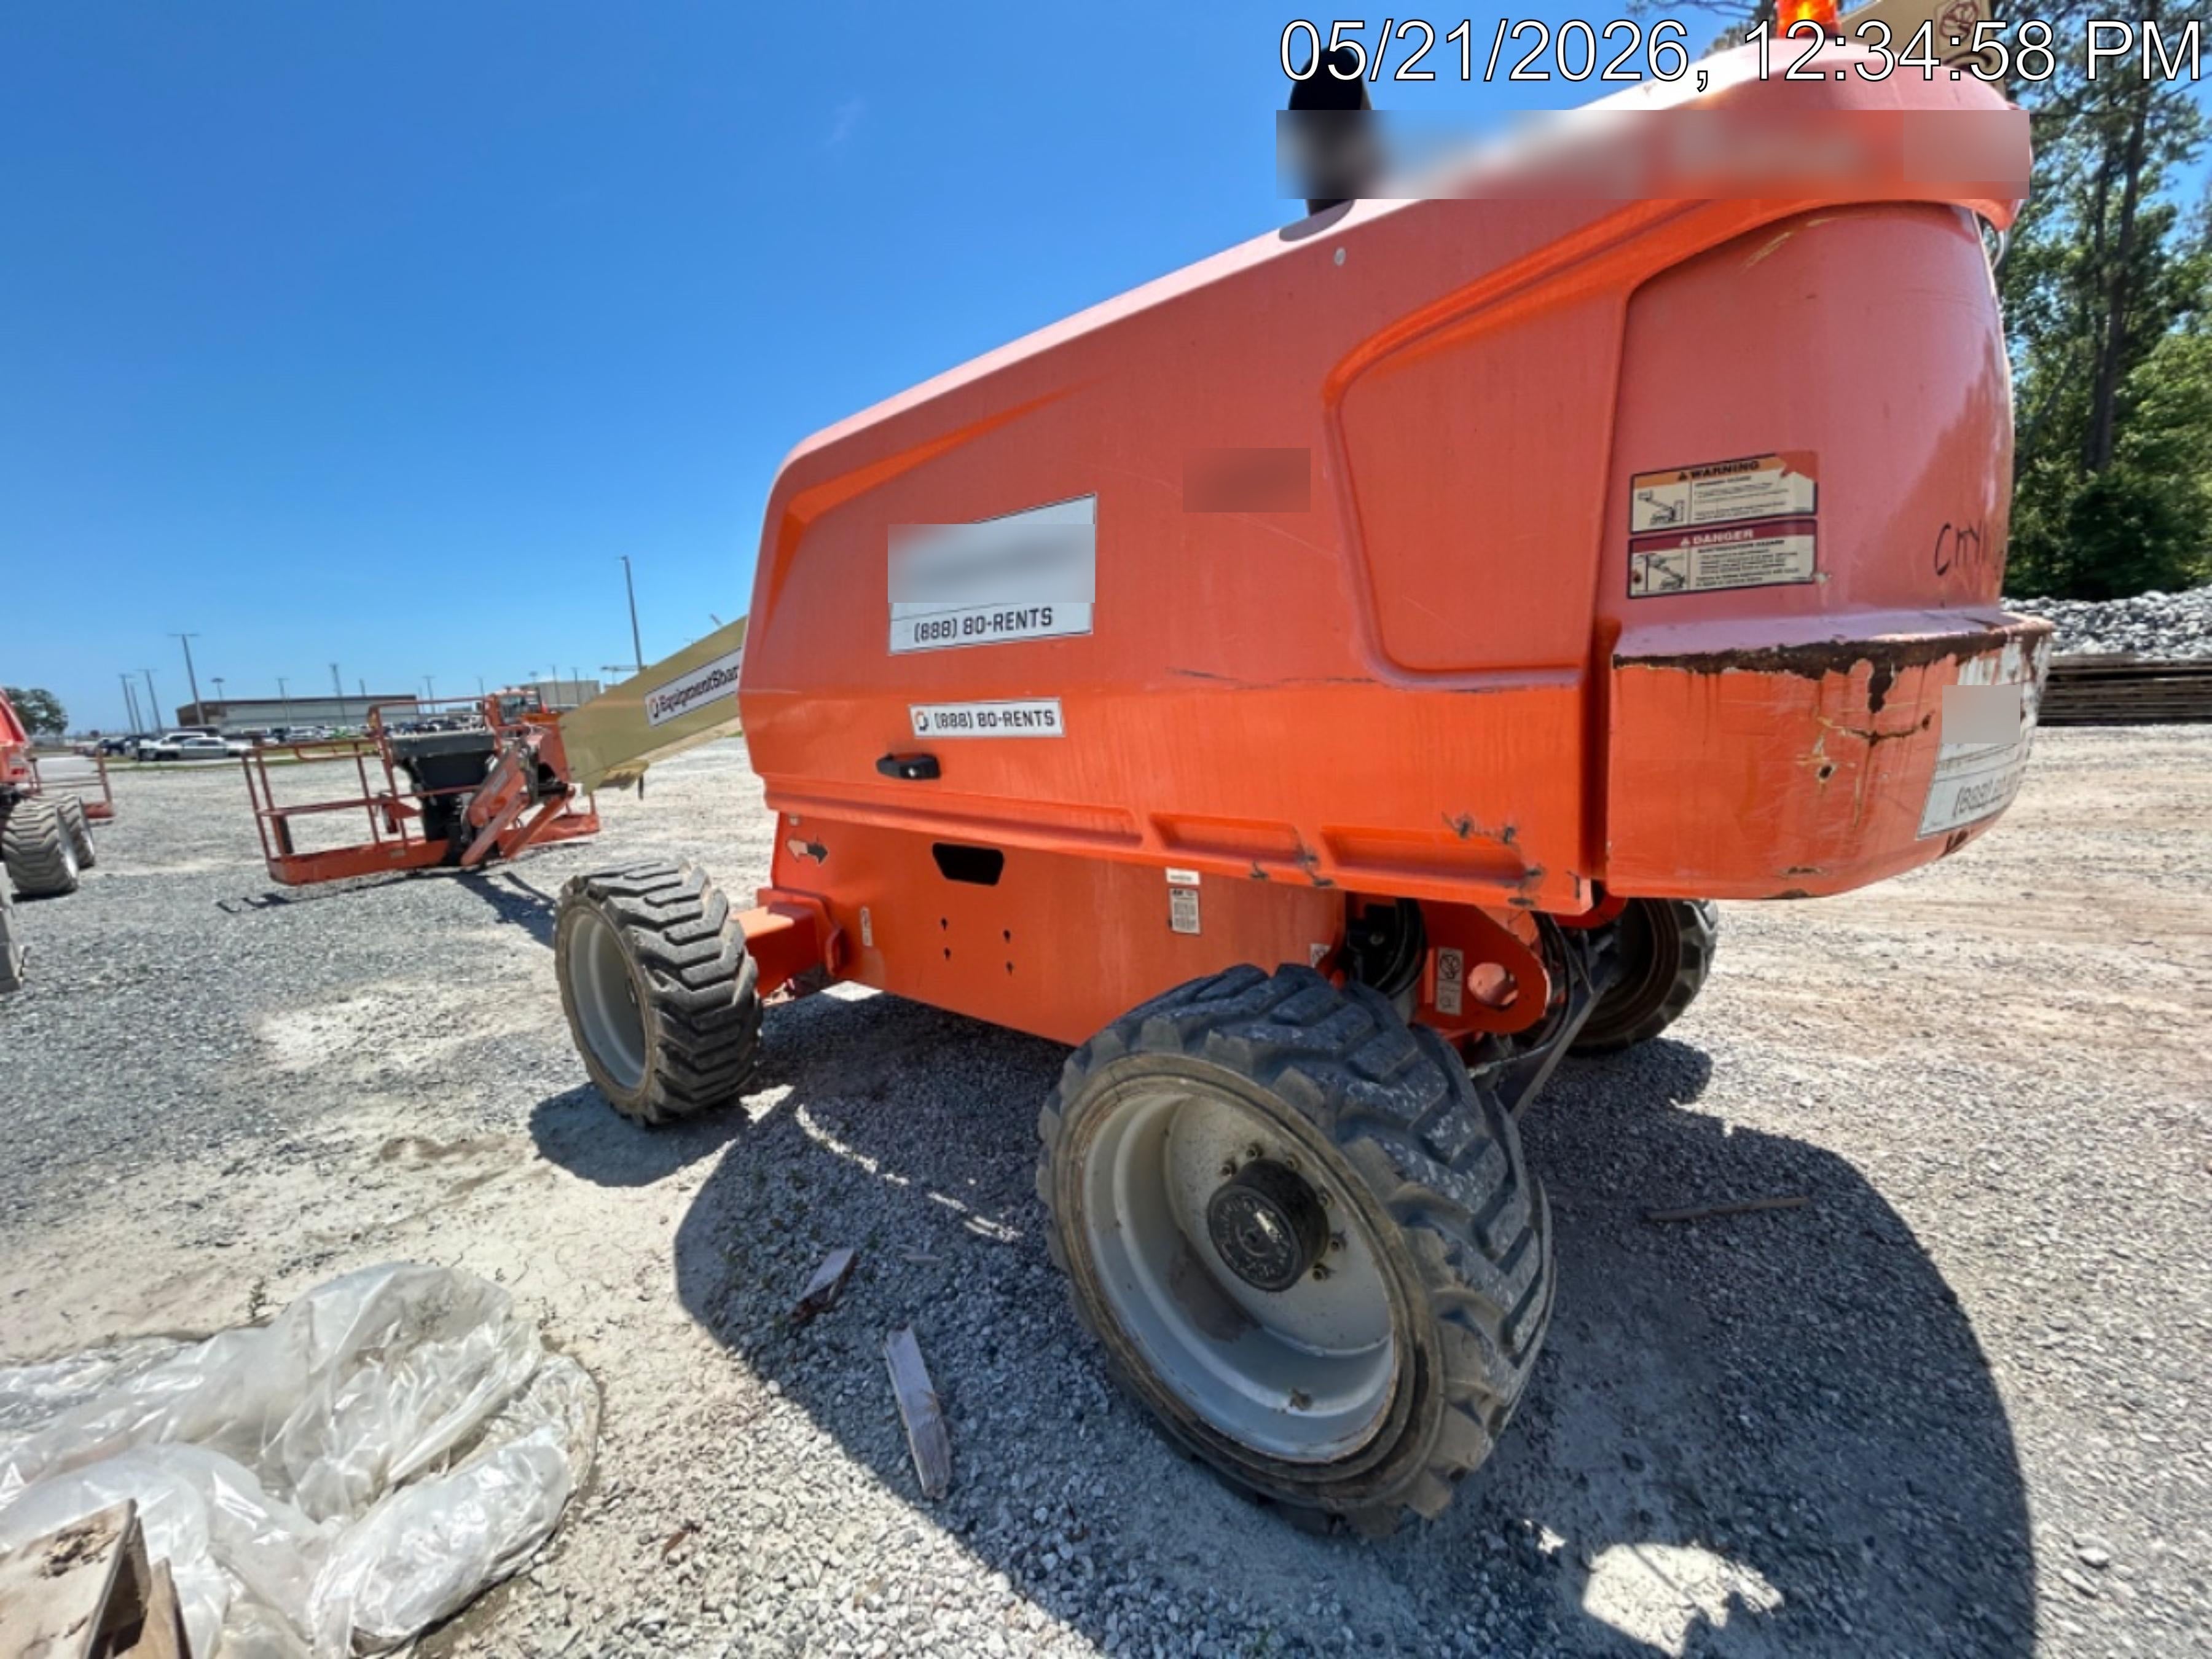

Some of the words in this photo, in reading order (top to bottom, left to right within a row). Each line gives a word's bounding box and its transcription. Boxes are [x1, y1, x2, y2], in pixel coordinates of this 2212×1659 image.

[1692, 461, 1759, 478] WARNING
[1693, 529, 1754, 544] DANGER
[914, 618, 957, 643] (888)
[963, 607, 1053, 635] 80-RENTS
[934, 711, 973, 729] (888)
[977, 709, 1055, 728] 80-RENTS
